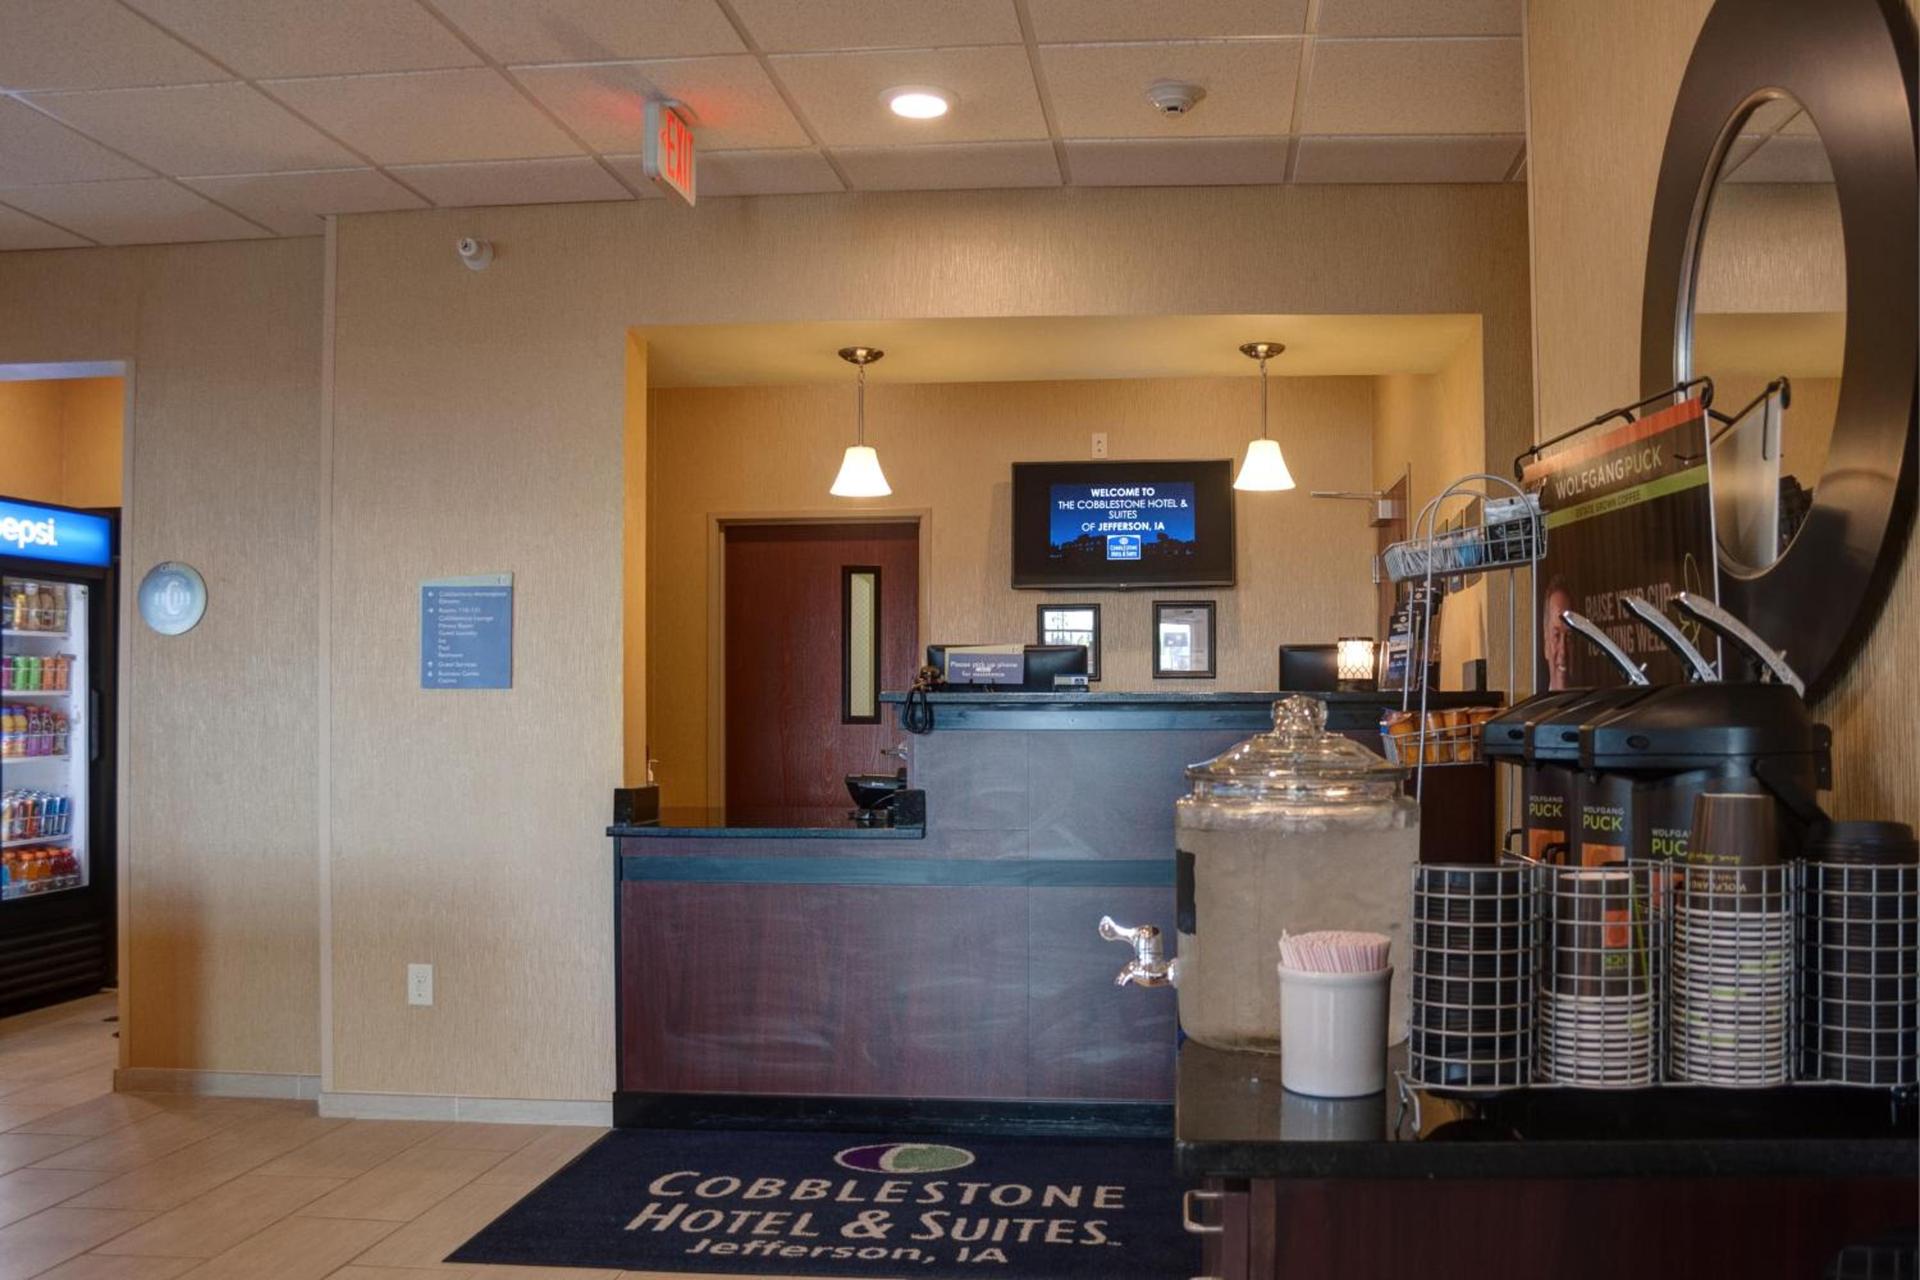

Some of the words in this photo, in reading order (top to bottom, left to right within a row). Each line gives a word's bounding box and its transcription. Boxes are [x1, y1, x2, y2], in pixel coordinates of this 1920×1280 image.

[665, 109, 694, 194] EXIT
[1091, 488, 1140, 498] WELCOME
[1141, 487, 1155, 497] TO
[1615, 489, 1641, 506] COFFEE
[1058, 500, 1075, 510] THE
[1077, 499, 1145, 510] COBBLESTONE
[1147, 499, 1179, 509] HOTEL
[1180, 499, 1188, 508] &
[1108, 510, 1138, 520] SUITES
[0, 516, 57, 549] epsi
[1081, 522, 1096, 532] OF
[1098, 521, 1152, 532] JEFFERSON,
[1154, 521, 1165, 531] IA
[1647, 582, 1672, 613] CUP
[1529, 803, 1562, 818] PUCK
[1583, 806, 1625, 815] WOLFGANG
[1583, 814, 1623, 831] PUCK
[1652, 828, 1690, 838] WOLFGA
[1652, 838, 1689, 856] PUC
[648, 1170, 1127, 1209] COBBLESTONE
[624, 1202, 822, 1238] HOTEL
[840, 1208, 894, 1241] &
[911, 1208, 1112, 1246] SUITES
[685, 1236, 937, 1265] Jefferson,
[956, 1244, 1009, 1264] IA
